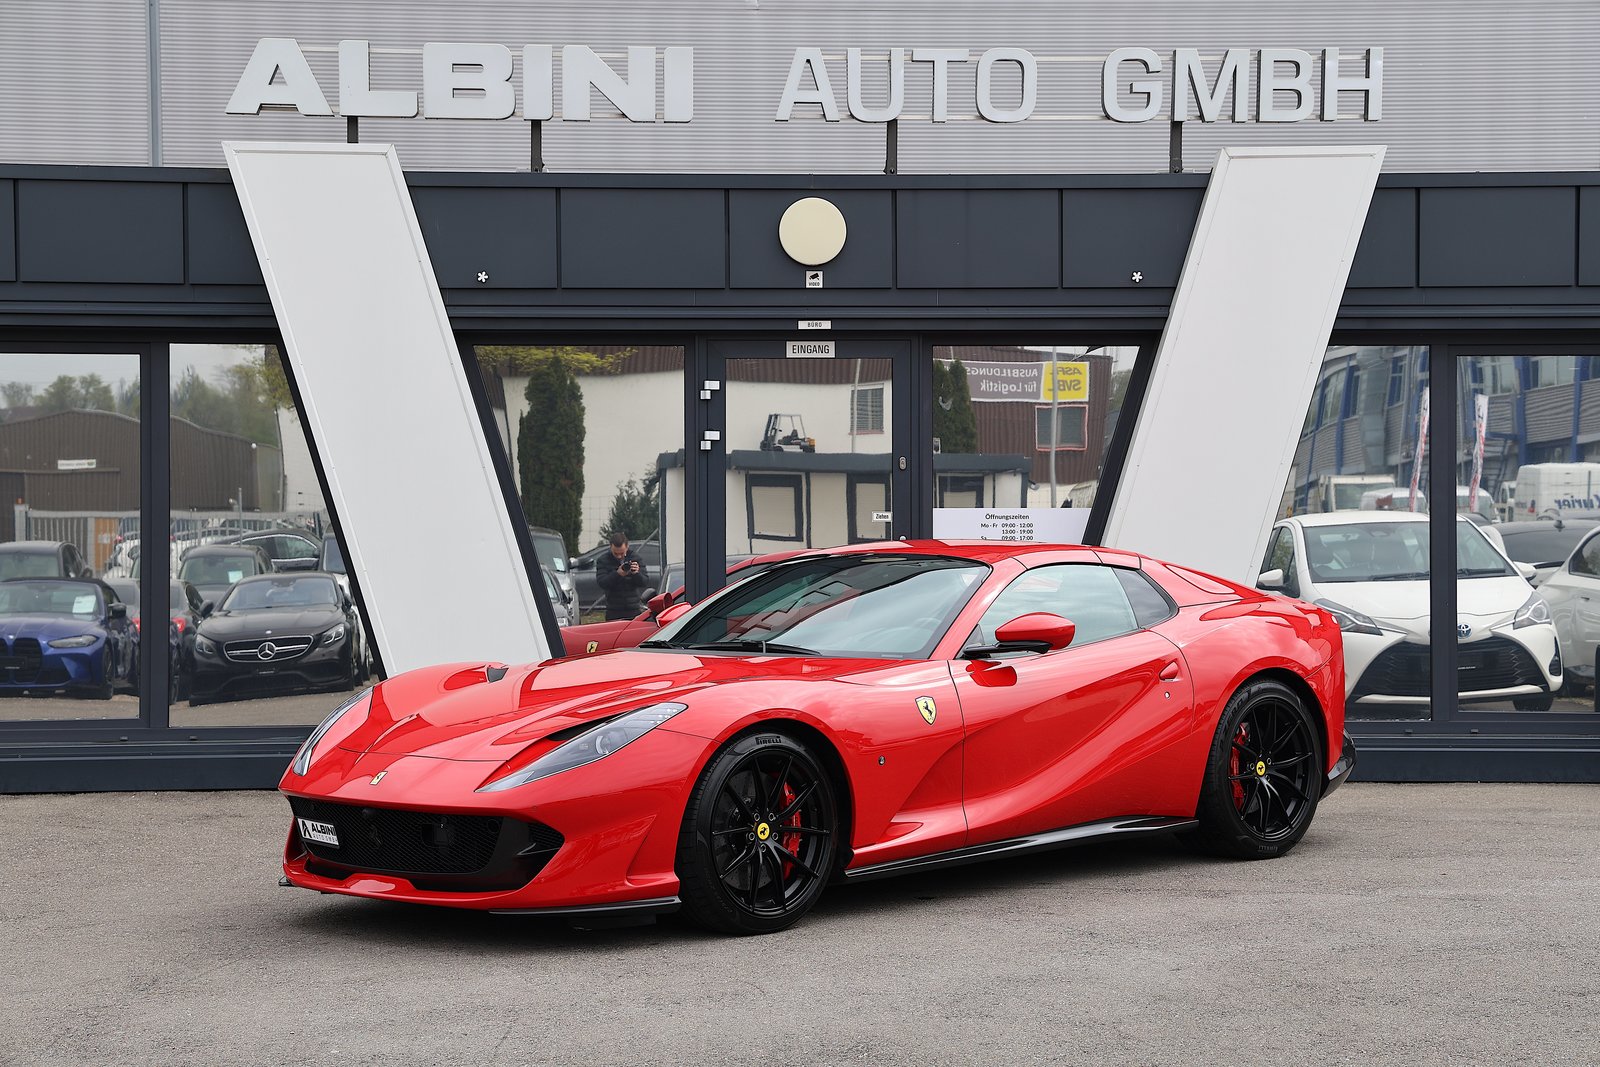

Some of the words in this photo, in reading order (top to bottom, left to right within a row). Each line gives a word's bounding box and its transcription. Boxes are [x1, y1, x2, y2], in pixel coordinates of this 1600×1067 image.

[225, 37, 694, 123] ALBINI
[775, 47, 1038, 123] AUTO
[1101, 46, 1384, 123] GMBH
[792, 344, 830, 354] EINGANG
[755, 735, 782, 745] PIRELLI
[312, 823, 336, 836] ALBINI
